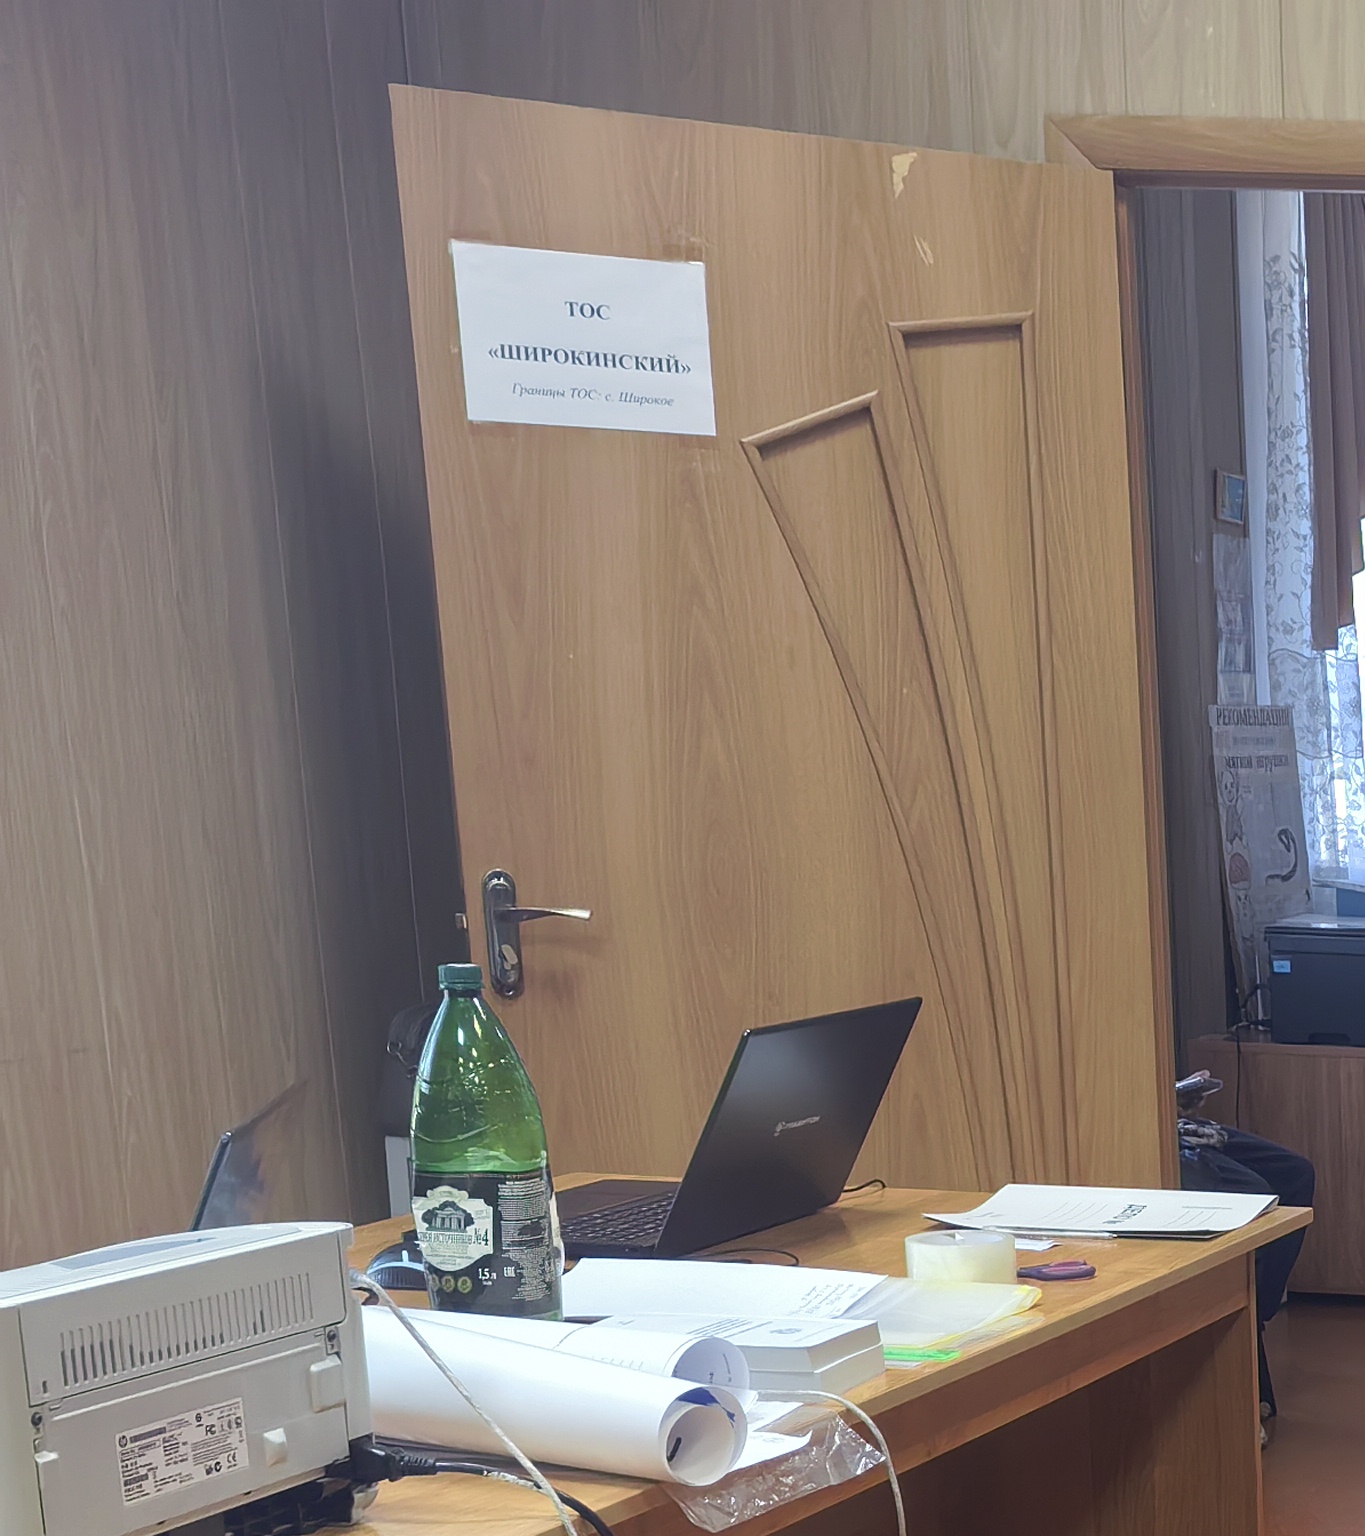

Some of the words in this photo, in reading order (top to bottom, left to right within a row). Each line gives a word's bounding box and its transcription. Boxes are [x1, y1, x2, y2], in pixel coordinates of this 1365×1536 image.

[564, 300, 612, 321] ТОС
[487, 343, 692, 375] «ШИРОКИНСКИЙ»
[511, 382, 566, 399] Границы
[618, 391, 675, 407] Широкое
